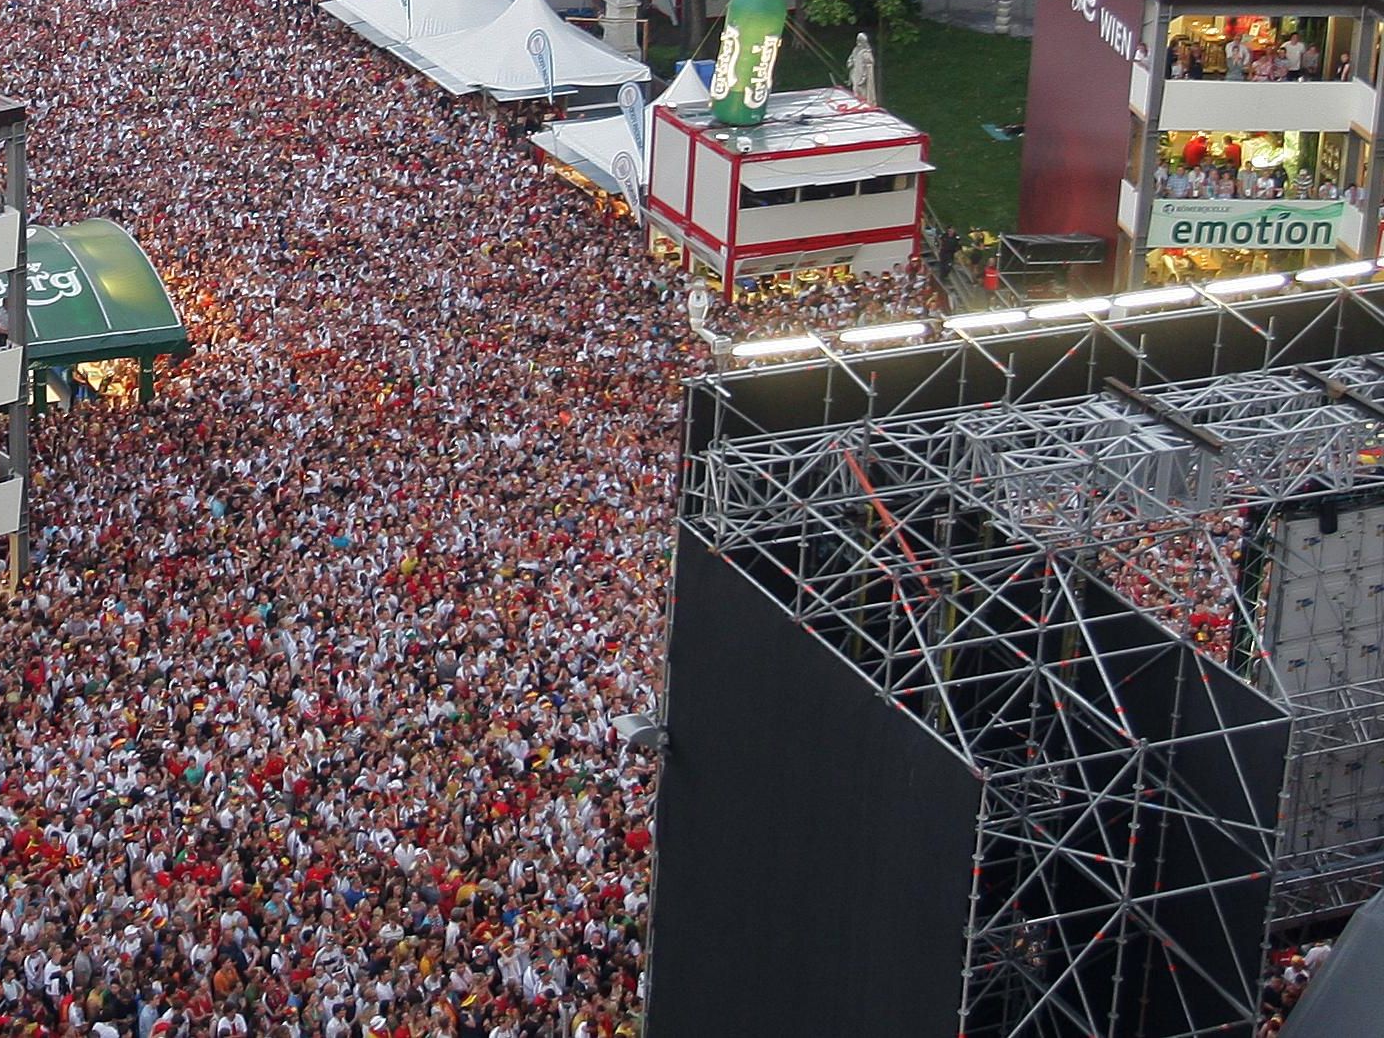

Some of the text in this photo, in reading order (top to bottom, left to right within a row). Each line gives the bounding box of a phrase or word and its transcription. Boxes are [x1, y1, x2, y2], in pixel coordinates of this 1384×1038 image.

[1100, 6, 1132, 61] WIEN
[744, 35, 782, 109] Carlsberg
[1172, 212, 1333, 245] emotion
